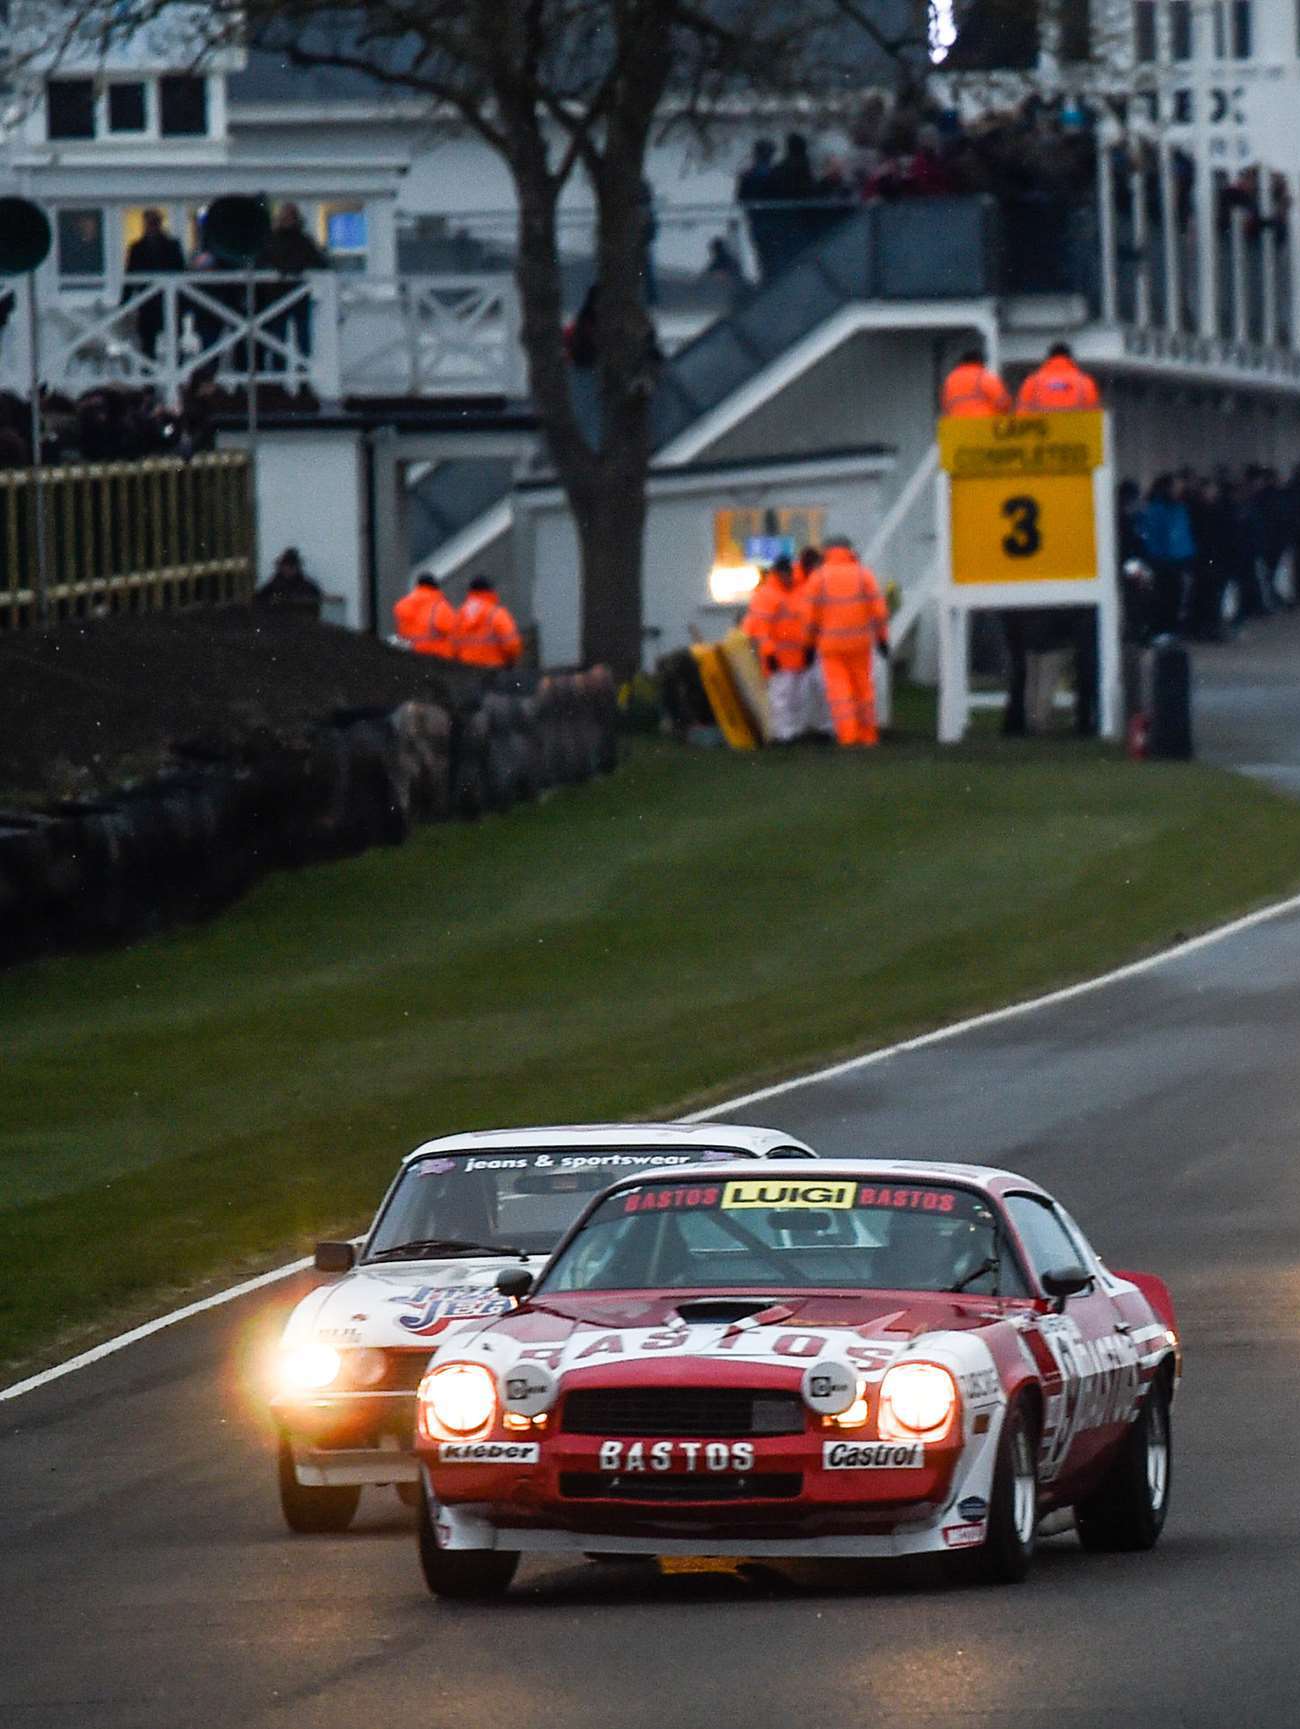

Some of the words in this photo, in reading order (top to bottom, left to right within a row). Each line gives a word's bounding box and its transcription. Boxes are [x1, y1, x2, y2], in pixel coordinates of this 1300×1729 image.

[1002, 495, 1041, 558] 3
[464, 1157, 528, 1173] jeans
[534, 1154, 555, 1168] &
[560, 1152, 693, 1169] sportswear
[623, 1185, 720, 1213] BASTOS
[730, 1185, 848, 1204] LUIGI
[859, 1187, 956, 1212] BASTOS
[600, 1440, 755, 1473] BASTOS
[828, 1443, 920, 1468] Castrol
